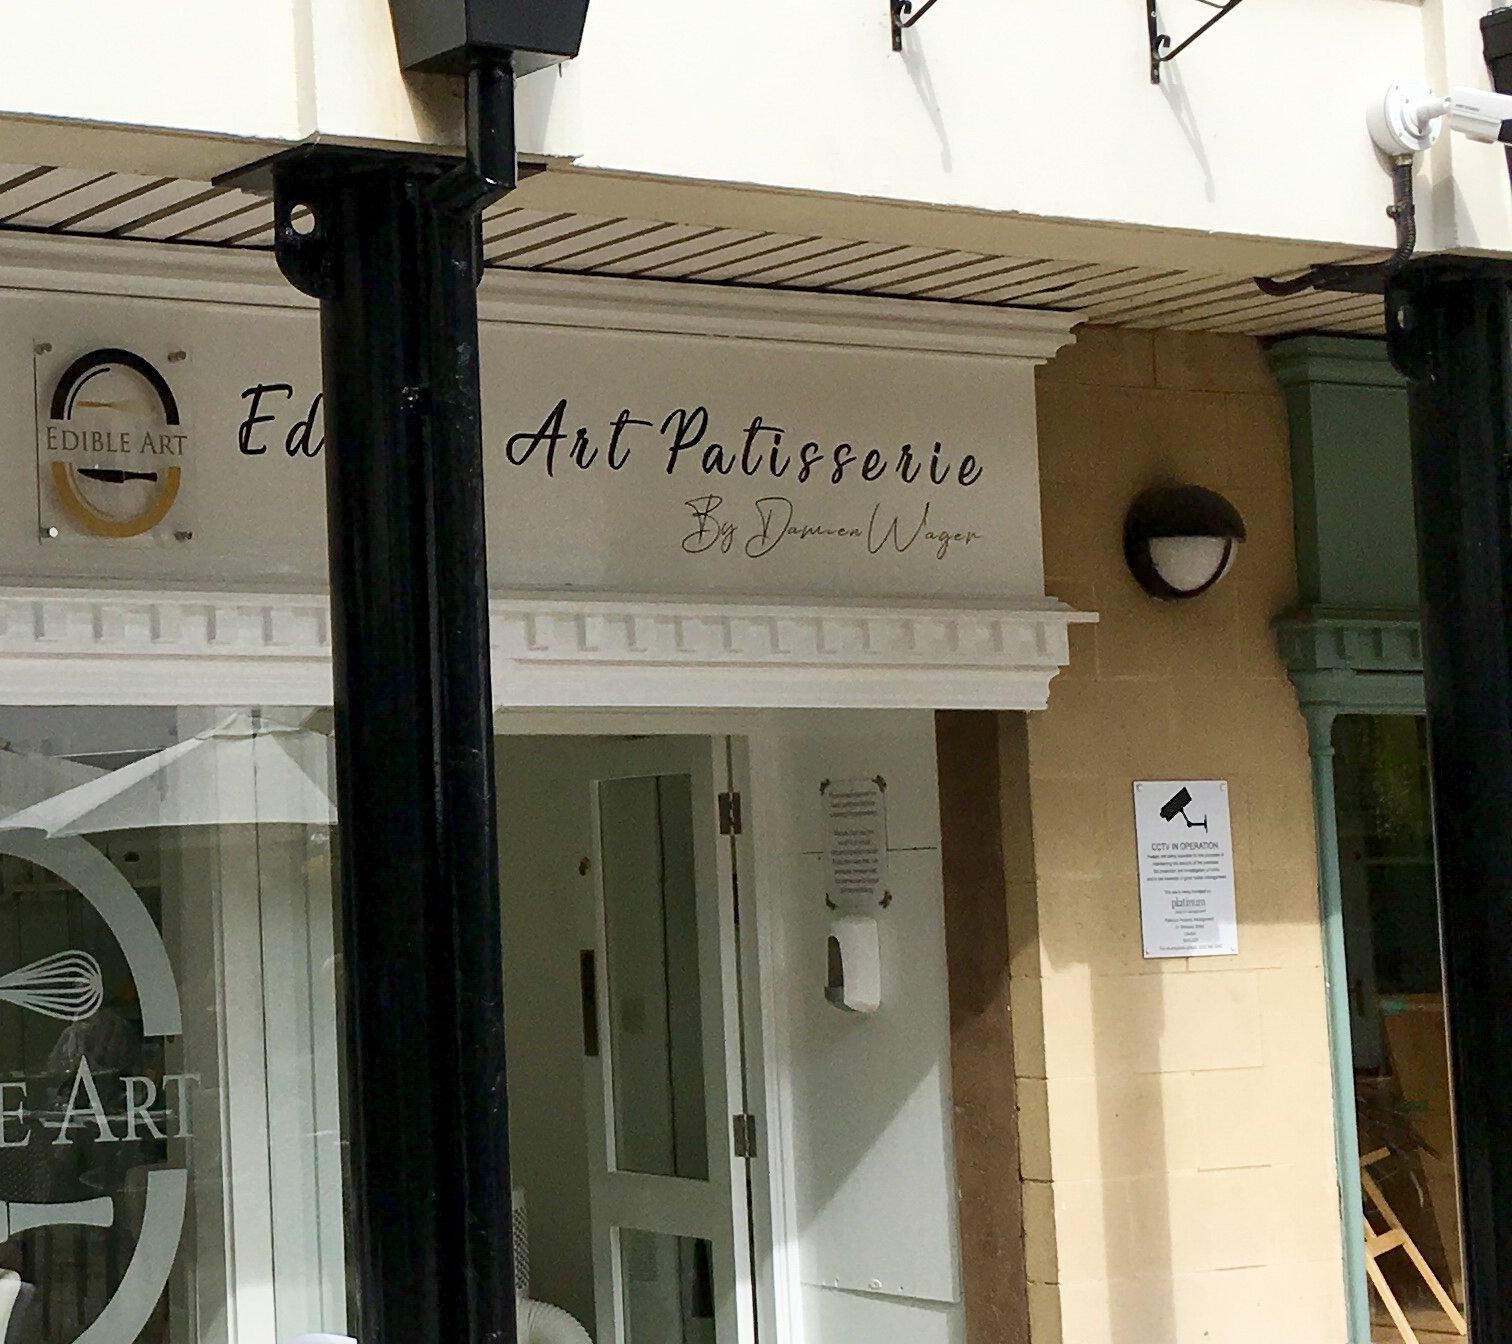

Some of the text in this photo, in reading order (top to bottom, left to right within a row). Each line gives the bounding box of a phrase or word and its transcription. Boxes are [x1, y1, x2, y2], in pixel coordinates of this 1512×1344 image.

[46, 425, 188, 456] EDIBLE ART
[505, 398, 984, 487] Art Patisserie
[681, 493, 984, 560] By Damien Wager
[1179, 841, 1219, 850] OPERATION
[51, 1054, 202, 1145] ART
